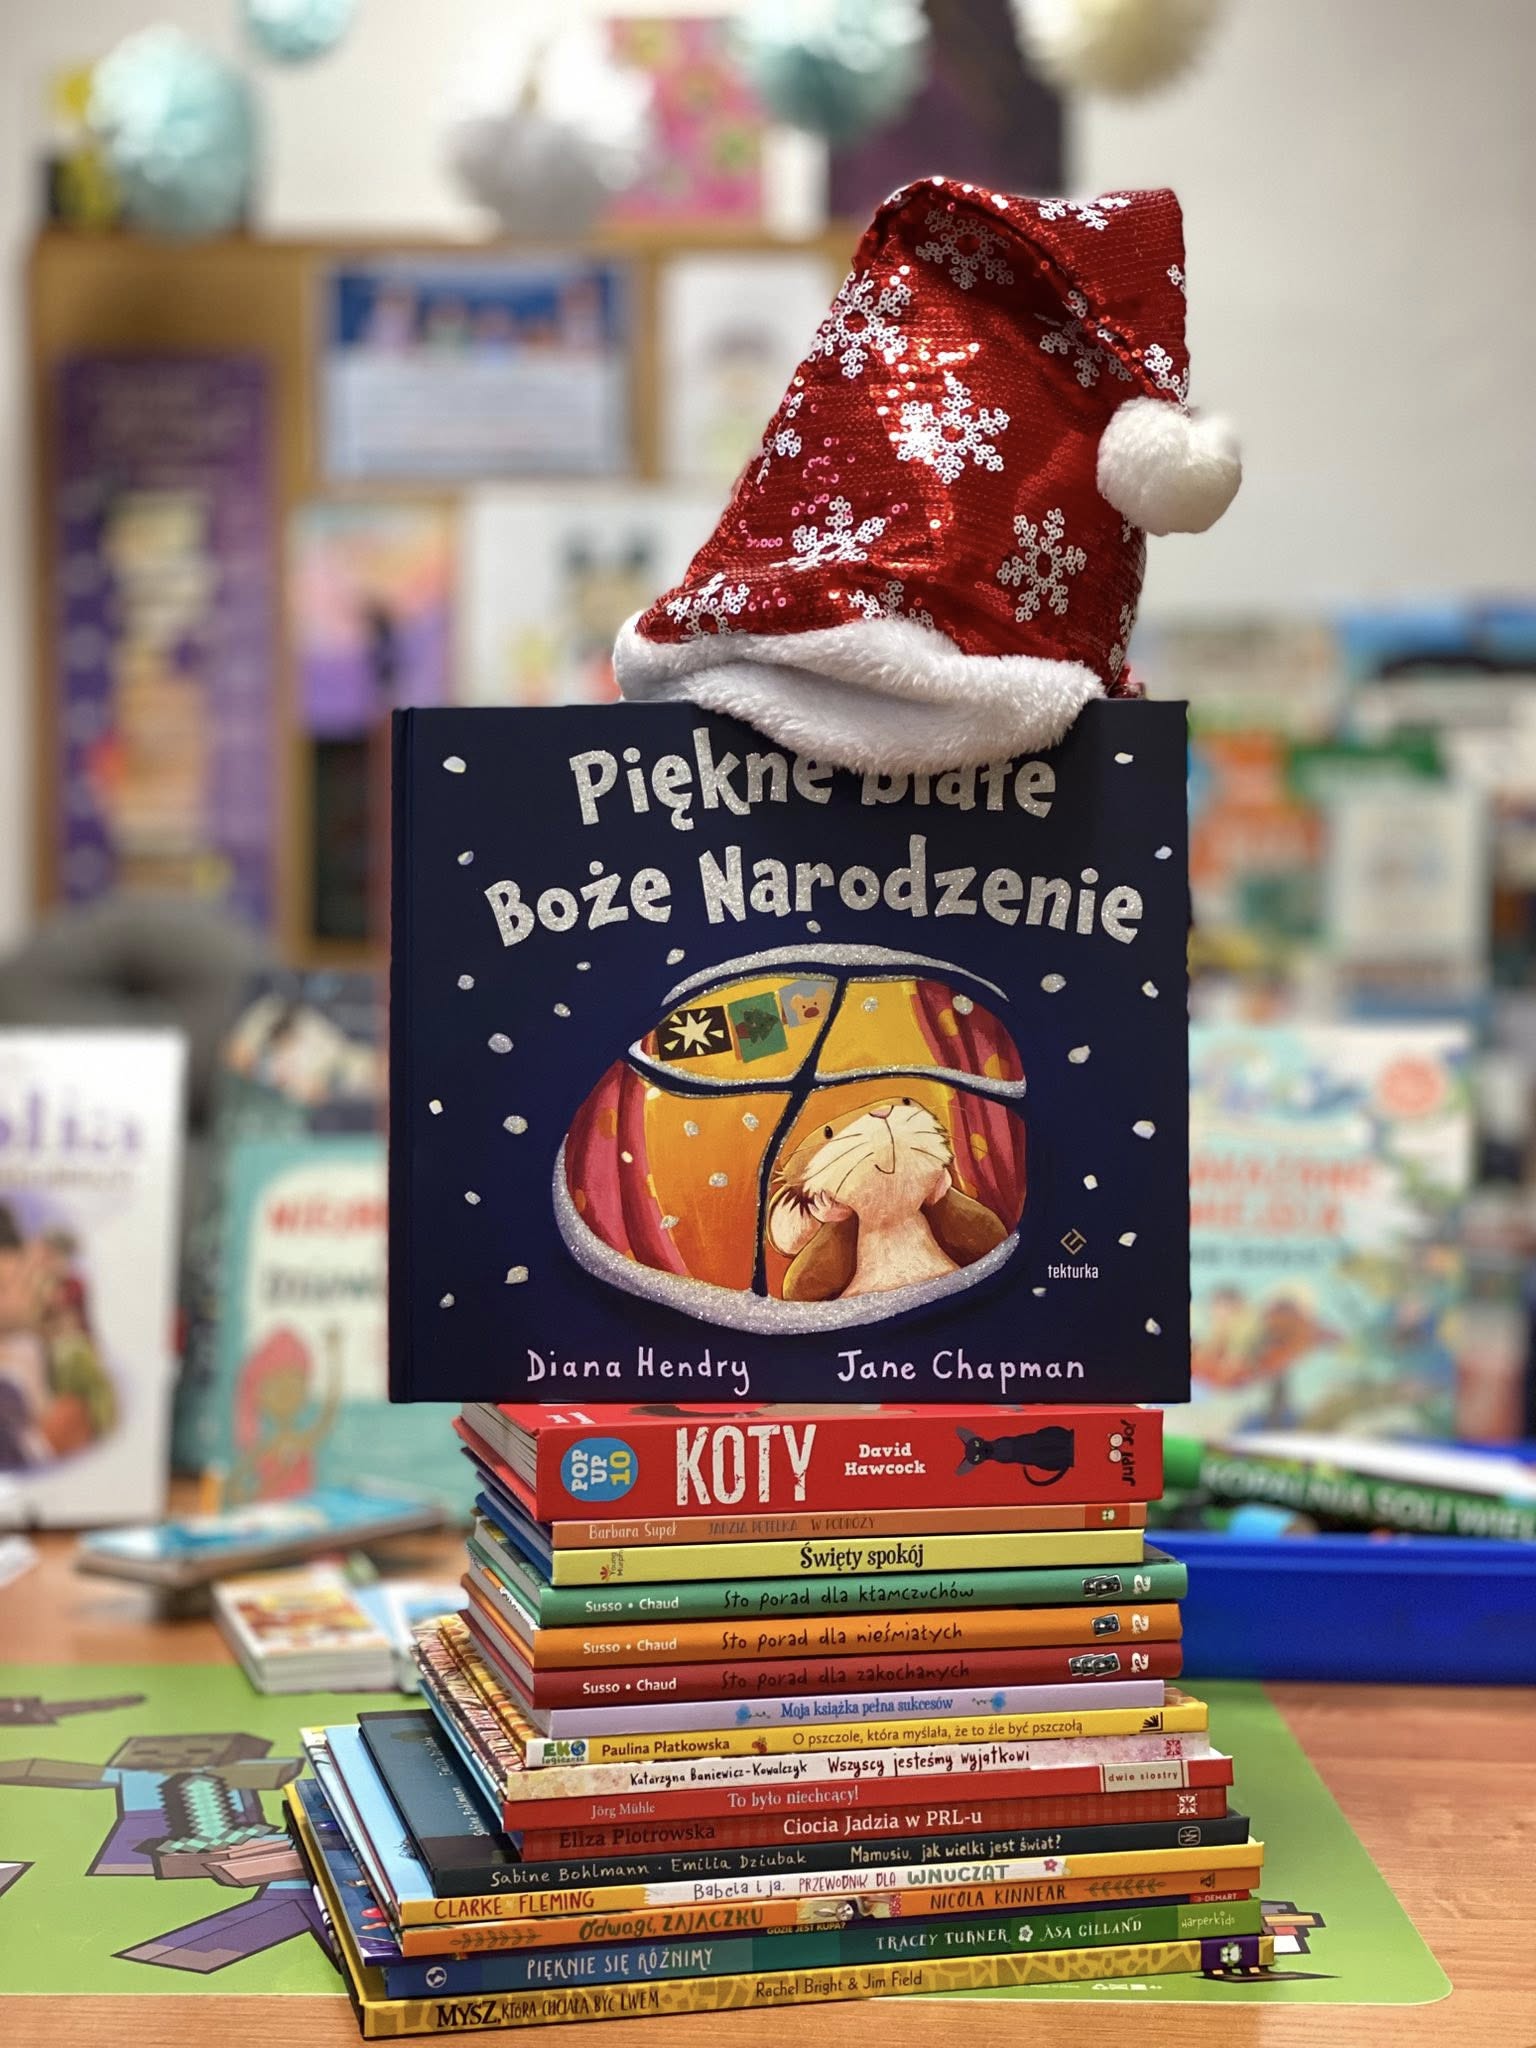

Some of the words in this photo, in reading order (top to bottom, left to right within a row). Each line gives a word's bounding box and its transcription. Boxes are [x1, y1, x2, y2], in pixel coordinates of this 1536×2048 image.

[569, 727, 834, 831] Piękne
[484, 861, 671, 947] Boże
[699, 834, 1143, 944] Narodzenie
[1048, 1263, 1099, 1279] tekturka
[527, 1349, 621, 1381] Diana
[638, 1347, 749, 1396] Hendry
[837, 1350, 916, 1381] Jane
[932, 1349, 1085, 1394] Chapman
[858, 1442, 912, 1458] David
[571, 1450, 588, 1491] POP
[590, 1455, 607, 1484] UP
[610, 1451, 631, 1485] 10
[676, 1424, 817, 1506] KOTY
[844, 1460, 926, 1476] Hawcock
[589, 1525, 639, 1539] Barbara
[644, 1521, 677, 1540] Supeł
[800, 1542, 862, 1571] Święty
[867, 1543, 924, 1569] spokój
[585, 1601, 622, 1612] Susso
[639, 1596, 679, 1610] Chaud
[725, 1590, 749, 1608] Sto
[760, 1588, 809, 1610] porad
[821, 1586, 848, 1604] dla
[859, 1580, 974, 1602] kłamczuchów
[583, 1642, 620, 1654] Susso
[637, 1638, 677, 1651] Chaud
[722, 1632, 746, 1649] Sto
[757, 1628, 808, 1651] porad
[820, 1627, 846, 1645] dla
[857, 1622, 962, 1643] nieśmiałych
[583, 1682, 620, 1694] Susso
[636, 1677, 677, 1691] Chaud
[721, 1671, 746, 1690] Sto
[757, 1668, 807, 1690] porad
[820, 1666, 846, 1684] dla
[856, 1660, 969, 1682] zakochanych
[781, 1703, 810, 1720] Moja
[813, 1700, 859, 1718] książka
[862, 1698, 895, 1715] pełna
[897, 1697, 953, 1712] sukcesów
[793, 1733, 805, 1745] O
[808, 1730, 864, 1747] pszczole,
[867, 1728, 899, 1741] która
[903, 1725, 951, 1743] myślała,
[955, 1724, 968, 1737] że
[971, 1724, 985, 1736] to
[989, 1722, 1005, 1735] źle
[1008, 1720, 1029, 1737] być
[1033, 1719, 1083, 1736] pszczołą
[602, 1742, 650, 1757] Paulina
[654, 1738, 730, 1753] Płatkowska
[827, 1757, 885, 1777] Wszyscy
[893, 1752, 953, 1776] jesteśmy
[961, 1745, 1030, 1771] wyjątkowi
[630, 1773, 685, 1788] Katarzyna
[690, 1760, 808, 1782] Baniewicz-Kowalczyk
[1108, 1773, 1135, 1782] dwie
[1140, 1770, 1178, 1780] siostry
[591, 1804, 617, 1820] Jörg
[619, 1801, 656, 1816] Mühle
[728, 1793, 747, 1808] To
[752, 1791, 781, 1813] było
[786, 1786, 859, 1806] niechcący!
[559, 1830, 606, 1850] Eliza
[612, 1823, 716, 1845] Piotrowska
[784, 1818, 839, 1835] Ciocia
[844, 1812, 899, 1836] Jadzia
[905, 1815, 920, 1827] w
[926, 1809, 982, 1827] PRL-u
[921, 1843, 941, 1862] jak
[946, 1841, 985, 1857] wielki
[989, 1839, 1015, 1858] jest
[1020, 1834, 1062, 1851] świat?
[490, 1868, 551, 1888] Sabine
[559, 1863, 650, 1882] Bohlmann
[671, 1856, 731, 1873] Emilia
[740, 1851, 807, 1869] Dziubak
[694, 1882, 748, 1901] Babcia
[756, 1881, 762, 1893] i
[766, 1881, 785, 1898] ja.
[876, 1871, 896, 1887] DLA
[908, 1865, 1010, 1885] WNUCZĄT
[434, 1896, 503, 1919] CLARKE
[520, 1891, 595, 1913] FLEMING
[930, 1890, 985, 1910] NICOLA
[995, 1884, 1066, 1905] KINNEAR
[1204, 1893, 1237, 1901] DEMART
[580, 1918, 656, 1941] Odwagi,
[662, 1907, 764, 1935] ZAJĄCZKU
[767, 1925, 794, 1934] GDZIE
[795, 1924, 815, 1933] JEST
[817, 1922, 846, 1932] KUPA?
[876, 1933, 938, 1951] TRACEY
[944, 1928, 1011, 1946] TURNER
[1078, 1914, 1142, 1937] GILLAND
[527, 1957, 596, 1980] PIĘKNIE
[604, 1953, 630, 1975] SIĘ
[639, 1948, 713, 1975] RÓŻNIMY
[756, 1979, 799, 1998] Rachel
[804, 1975, 843, 1995] Bright
[848, 1978, 858, 1990] &
[863, 1974, 886, 1991] Jim
[891, 1970, 922, 1987] Field
[542, 1997, 589, 2017] CHCIAŁA
[621, 1990, 660, 2010] LWEM
